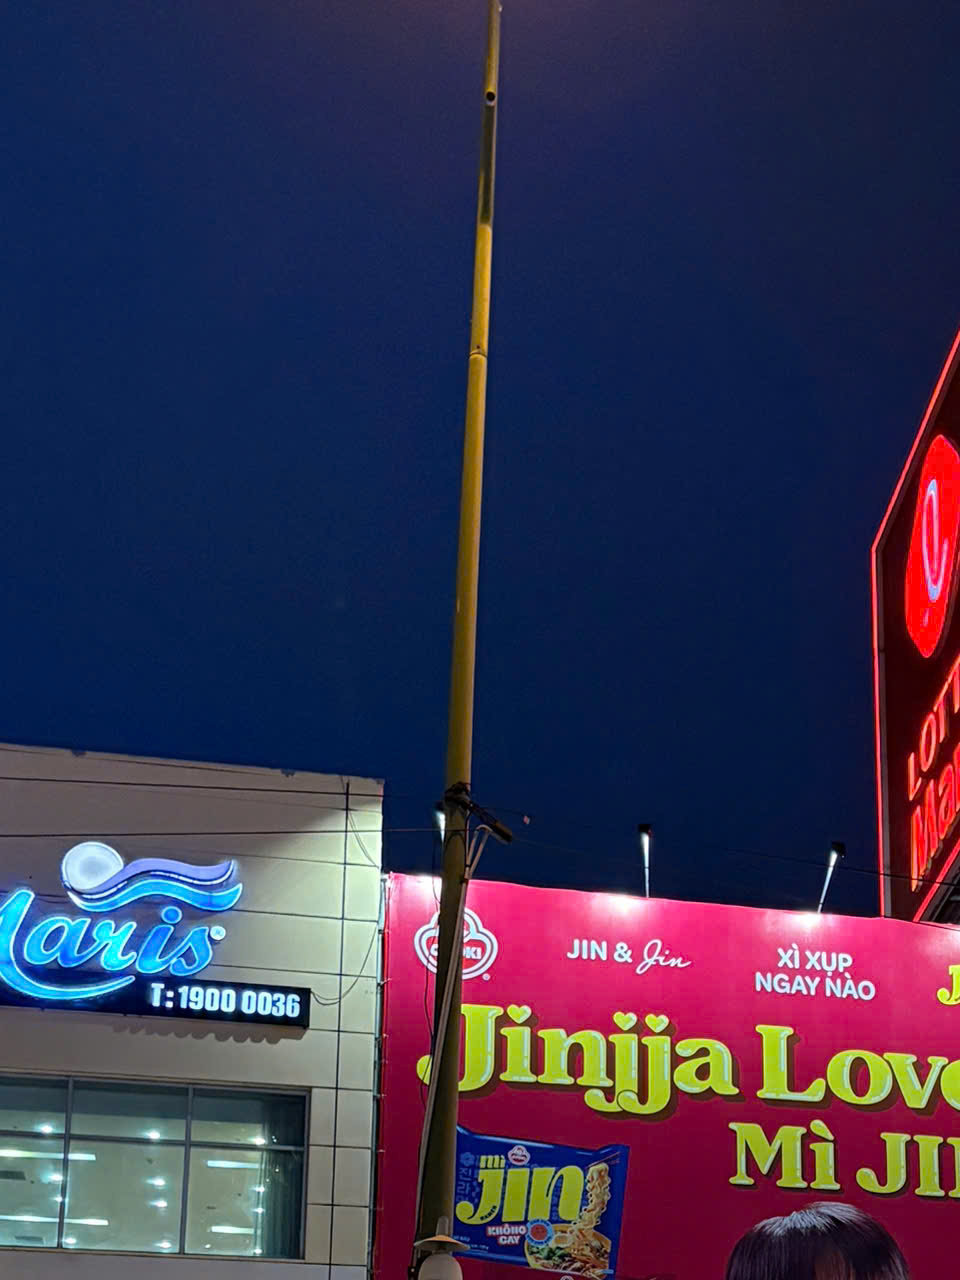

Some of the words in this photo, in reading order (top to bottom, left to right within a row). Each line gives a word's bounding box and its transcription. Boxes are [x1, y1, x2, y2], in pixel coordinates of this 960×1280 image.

[567, 939, 607, 961] JIN
[613, 942, 633, 963] &
[635, 939, 692, 975] Jin
[777, 943, 800, 969] XÌ
[805, 950, 853, 975] XỤP
[178, 985, 236, 1012] 1900
[241, 990, 301, 1018] 0036
[755, 972, 821, 996] NGAY
[825, 974, 876, 1001] NÀO
[416, 1003, 740, 1114] Jinjja
[728, 1119, 841, 1191] Mì
[498, 1234, 522, 1245] CAY
